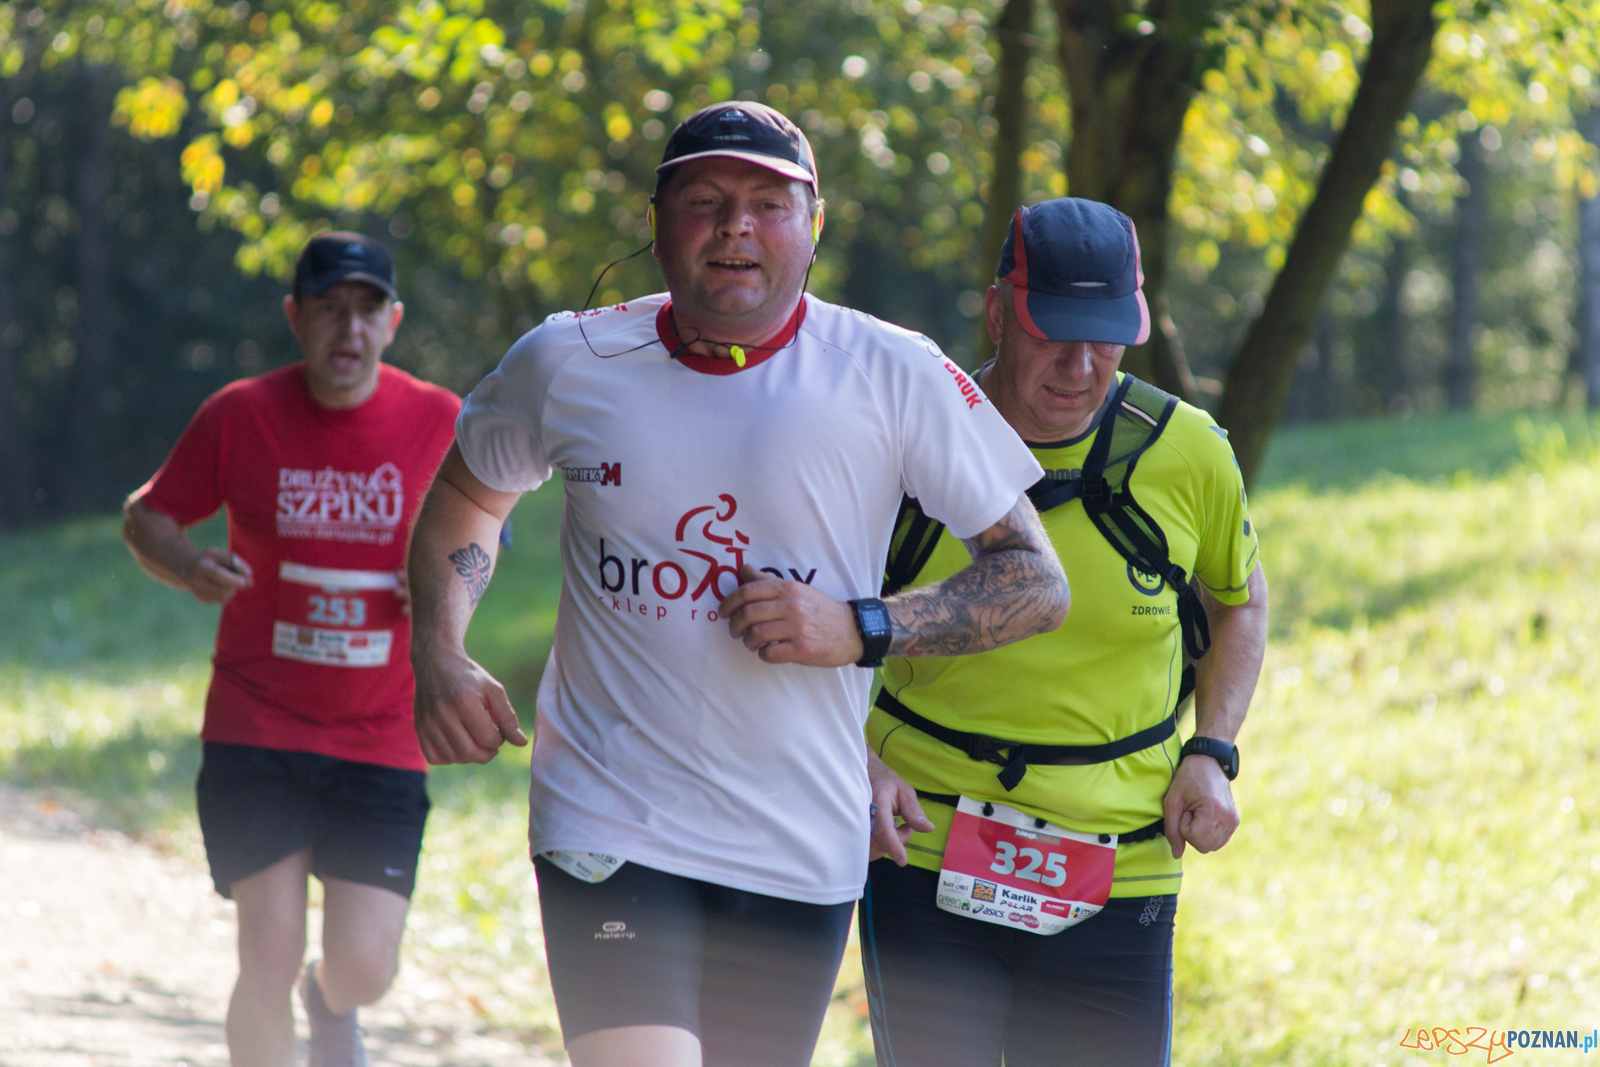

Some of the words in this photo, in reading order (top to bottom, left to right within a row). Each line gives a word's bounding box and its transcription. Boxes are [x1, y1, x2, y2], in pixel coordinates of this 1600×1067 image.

[944, 362, 983, 410] DRUK
[276, 490, 403, 526] SZPIKU
[307, 595, 367, 627] 253
[1131, 605, 1171, 616] ZDROWIE
[989, 840, 1068, 887] 325
[973, 884, 995, 897] 24
[1002, 888, 1038, 905] Karlik
[937, 894, 962, 905] green
[1000, 899, 1034, 912] POLAR
